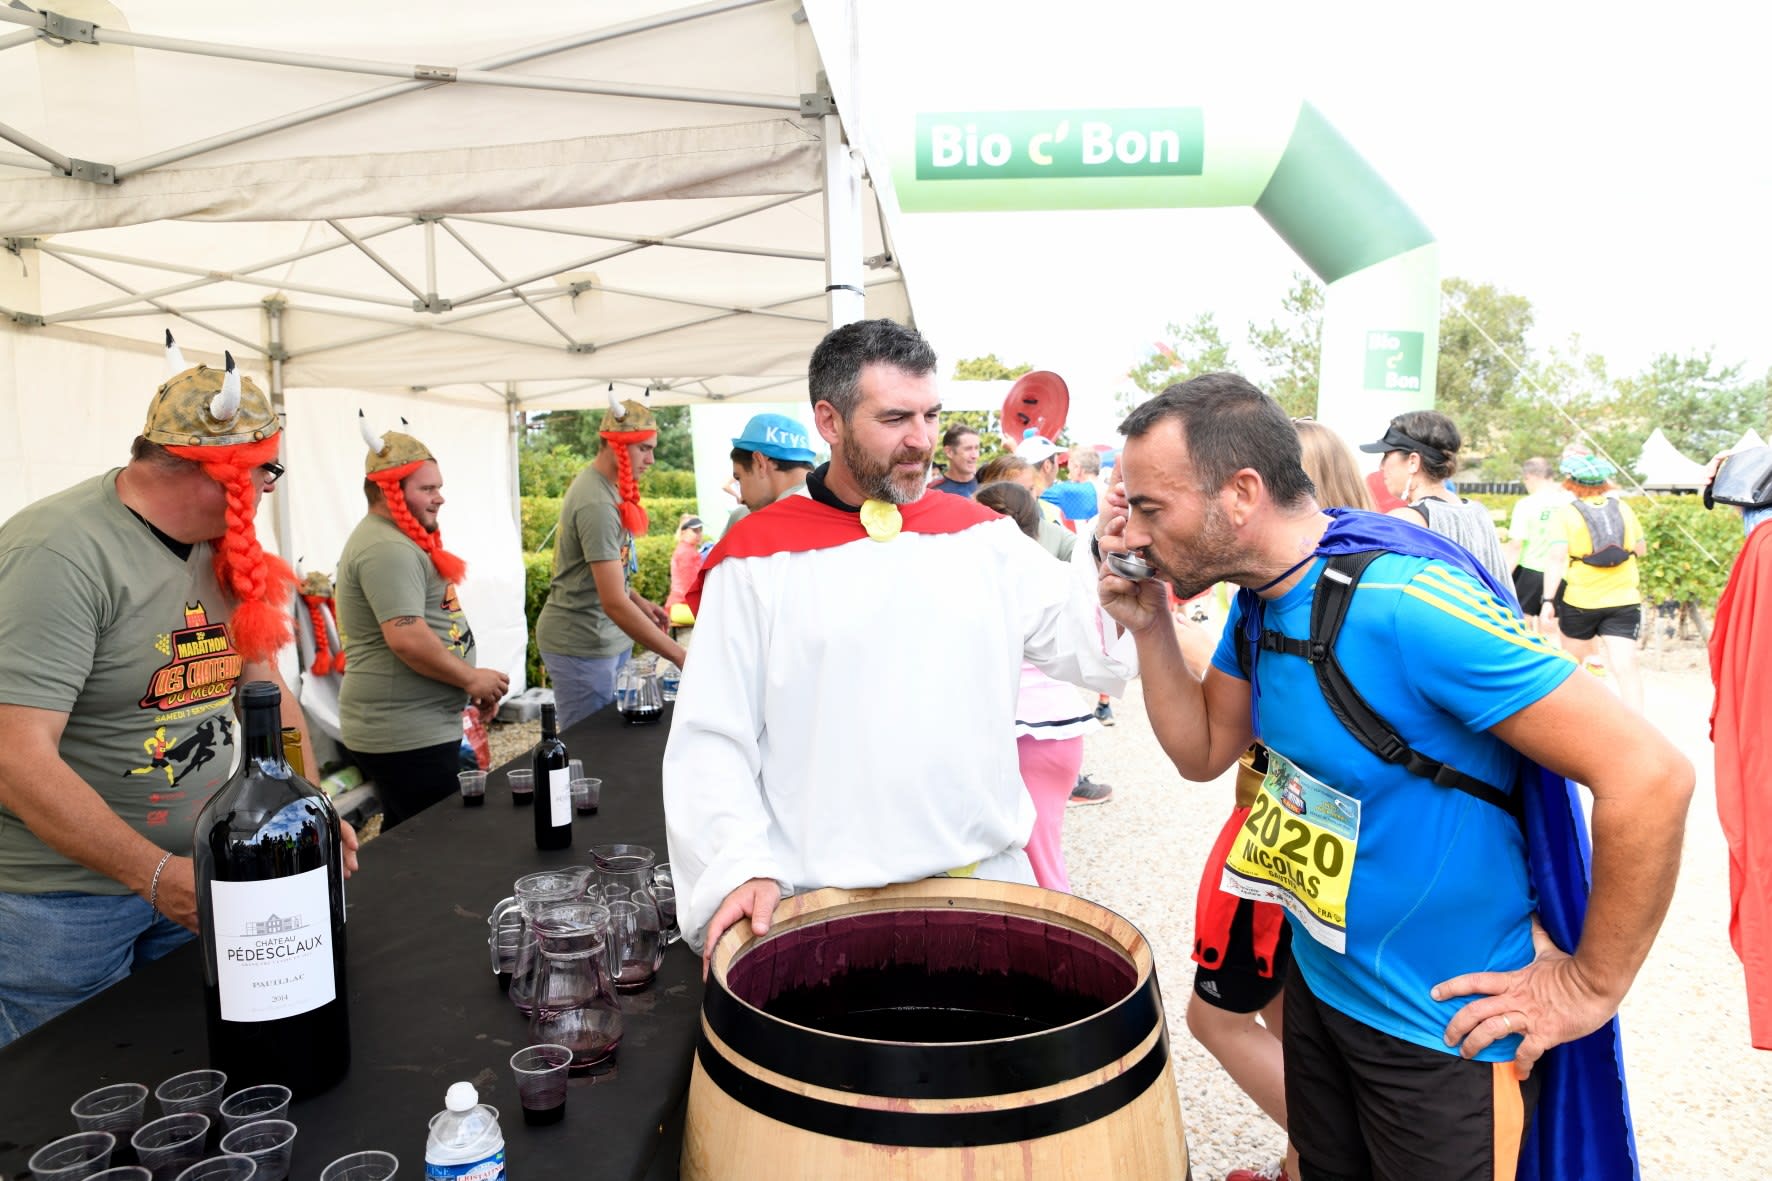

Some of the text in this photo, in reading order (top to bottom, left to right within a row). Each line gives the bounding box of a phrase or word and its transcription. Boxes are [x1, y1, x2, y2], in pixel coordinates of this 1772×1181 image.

[932, 119, 1180, 167] Bio c' Bon
[1385, 371, 1420, 389] Bon
[177, 636, 228, 659] MARATHON
[154, 664, 185, 697] DES
[167, 694, 185, 705] DU
[154, 711, 185, 723] SAMEDI
[1245, 792, 1344, 878] 2020
[1242, 838, 1321, 900] NICOLAS
[1317, 906, 1333, 920] FRA
[228, 934, 323, 962] PÉDESCLAUX
[255, 935, 297, 948] CHÂTEAU
[252, 973, 305, 989] PAUILLAC
